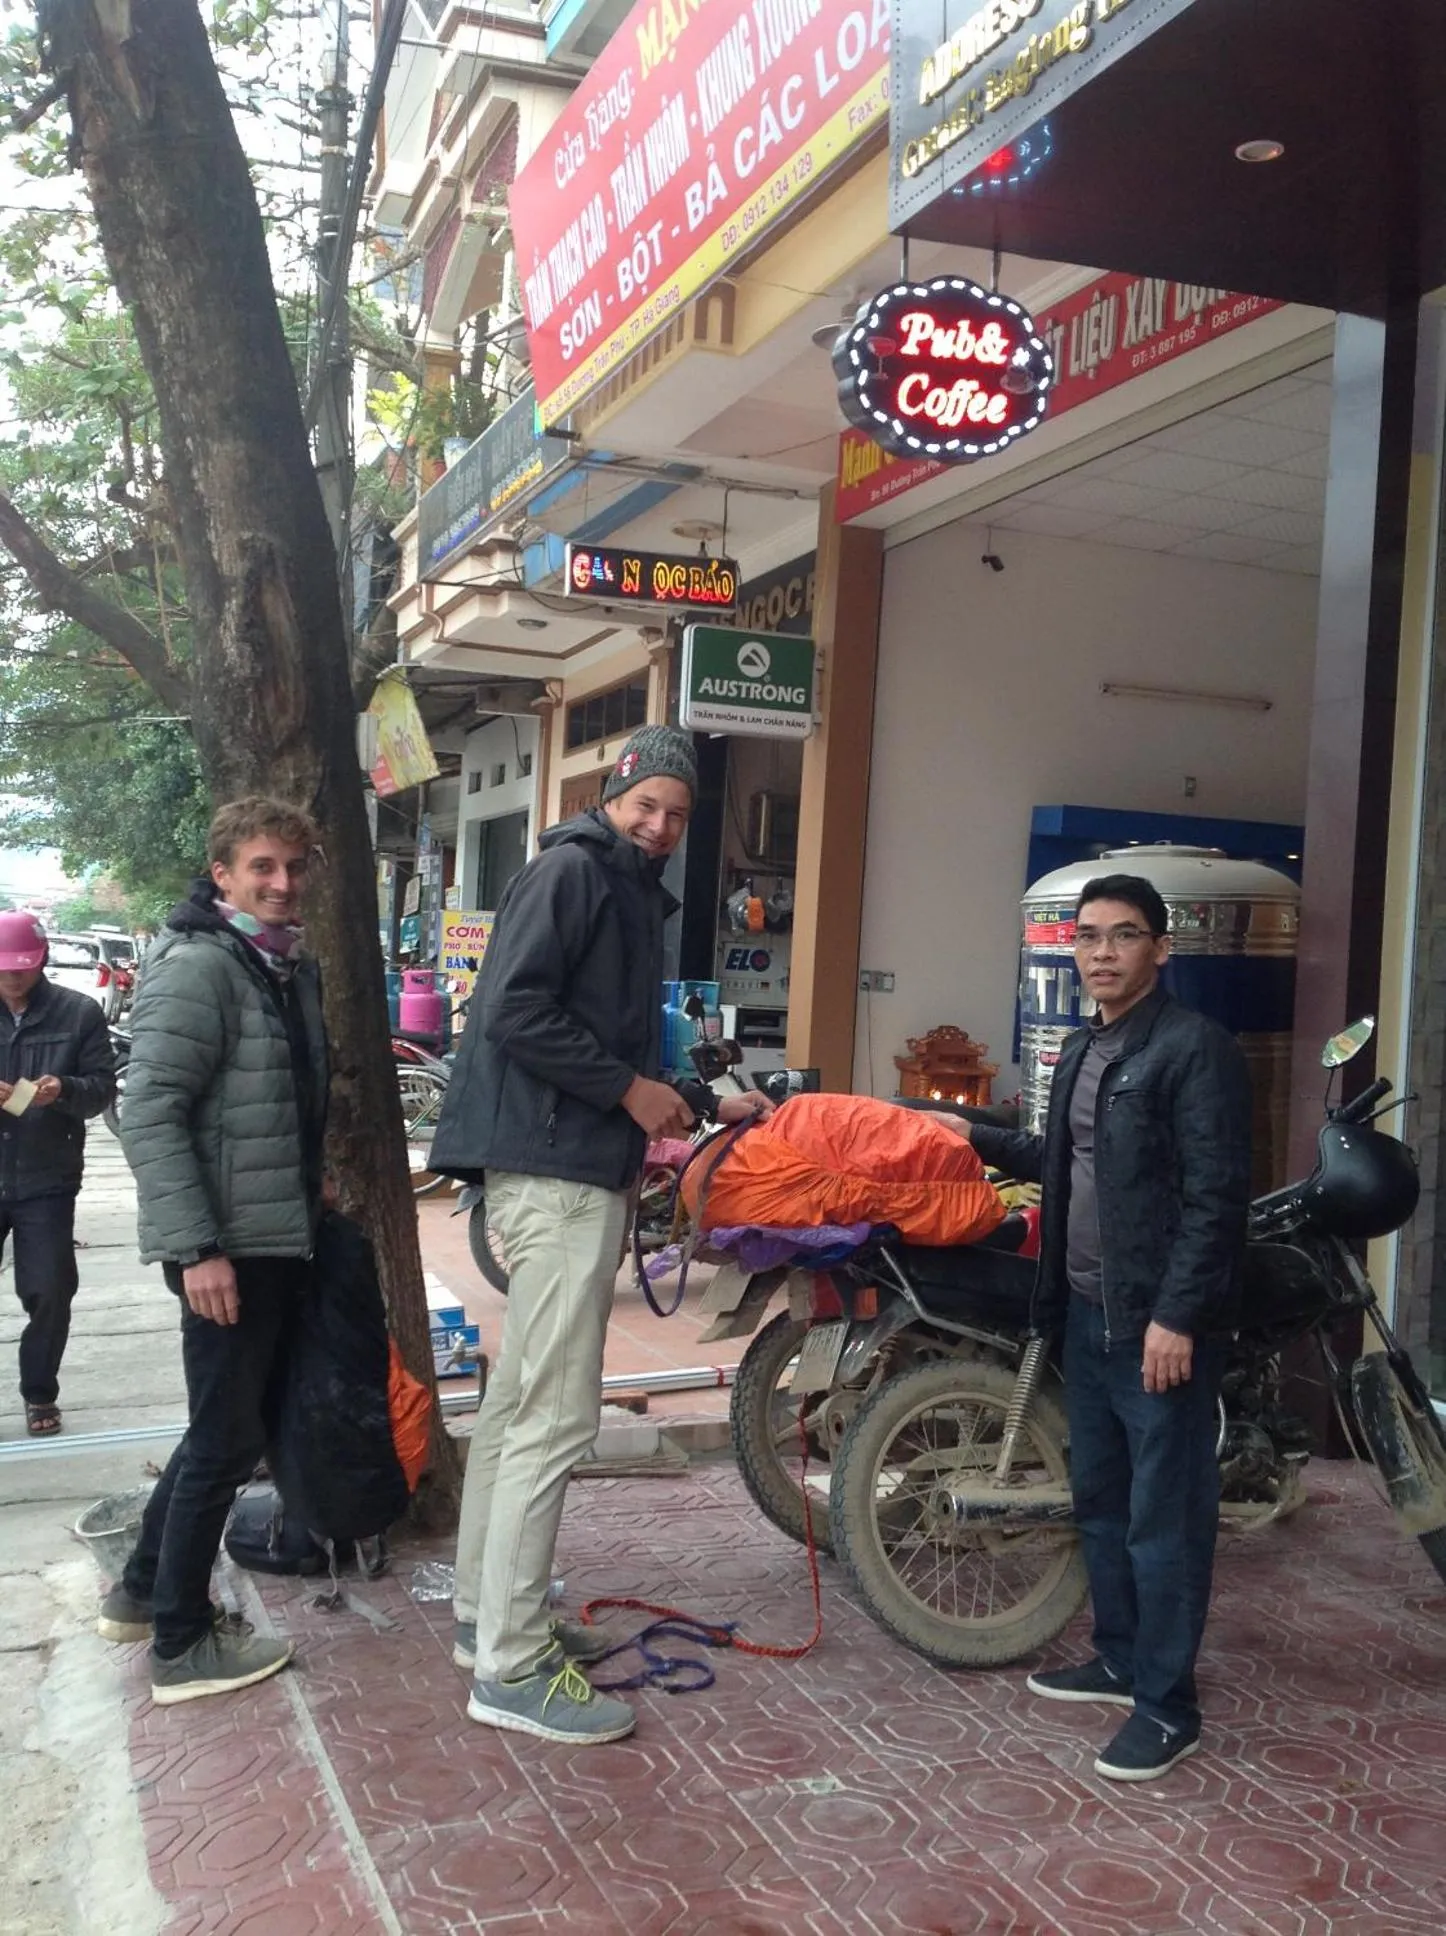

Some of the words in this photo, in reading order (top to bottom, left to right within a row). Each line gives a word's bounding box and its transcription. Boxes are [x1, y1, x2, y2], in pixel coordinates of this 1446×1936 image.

[580, 192, 608, 269] CAO
[643, 91, 690, 197] NHÔM
[695, 12, 756, 138] KHUNG
[616, 219, 664, 301] BỘT
[684, 143, 728, 232] BẢ
[733, 75, 805, 179] CÁC
[655, 284, 681, 316] Giang
[1069, 289, 1119, 380] LIỆU
[1176, 324, 1197, 345] 195
[897, 372, 1009, 428] Coffee
[698, 676, 806, 705] AUSTRONG
